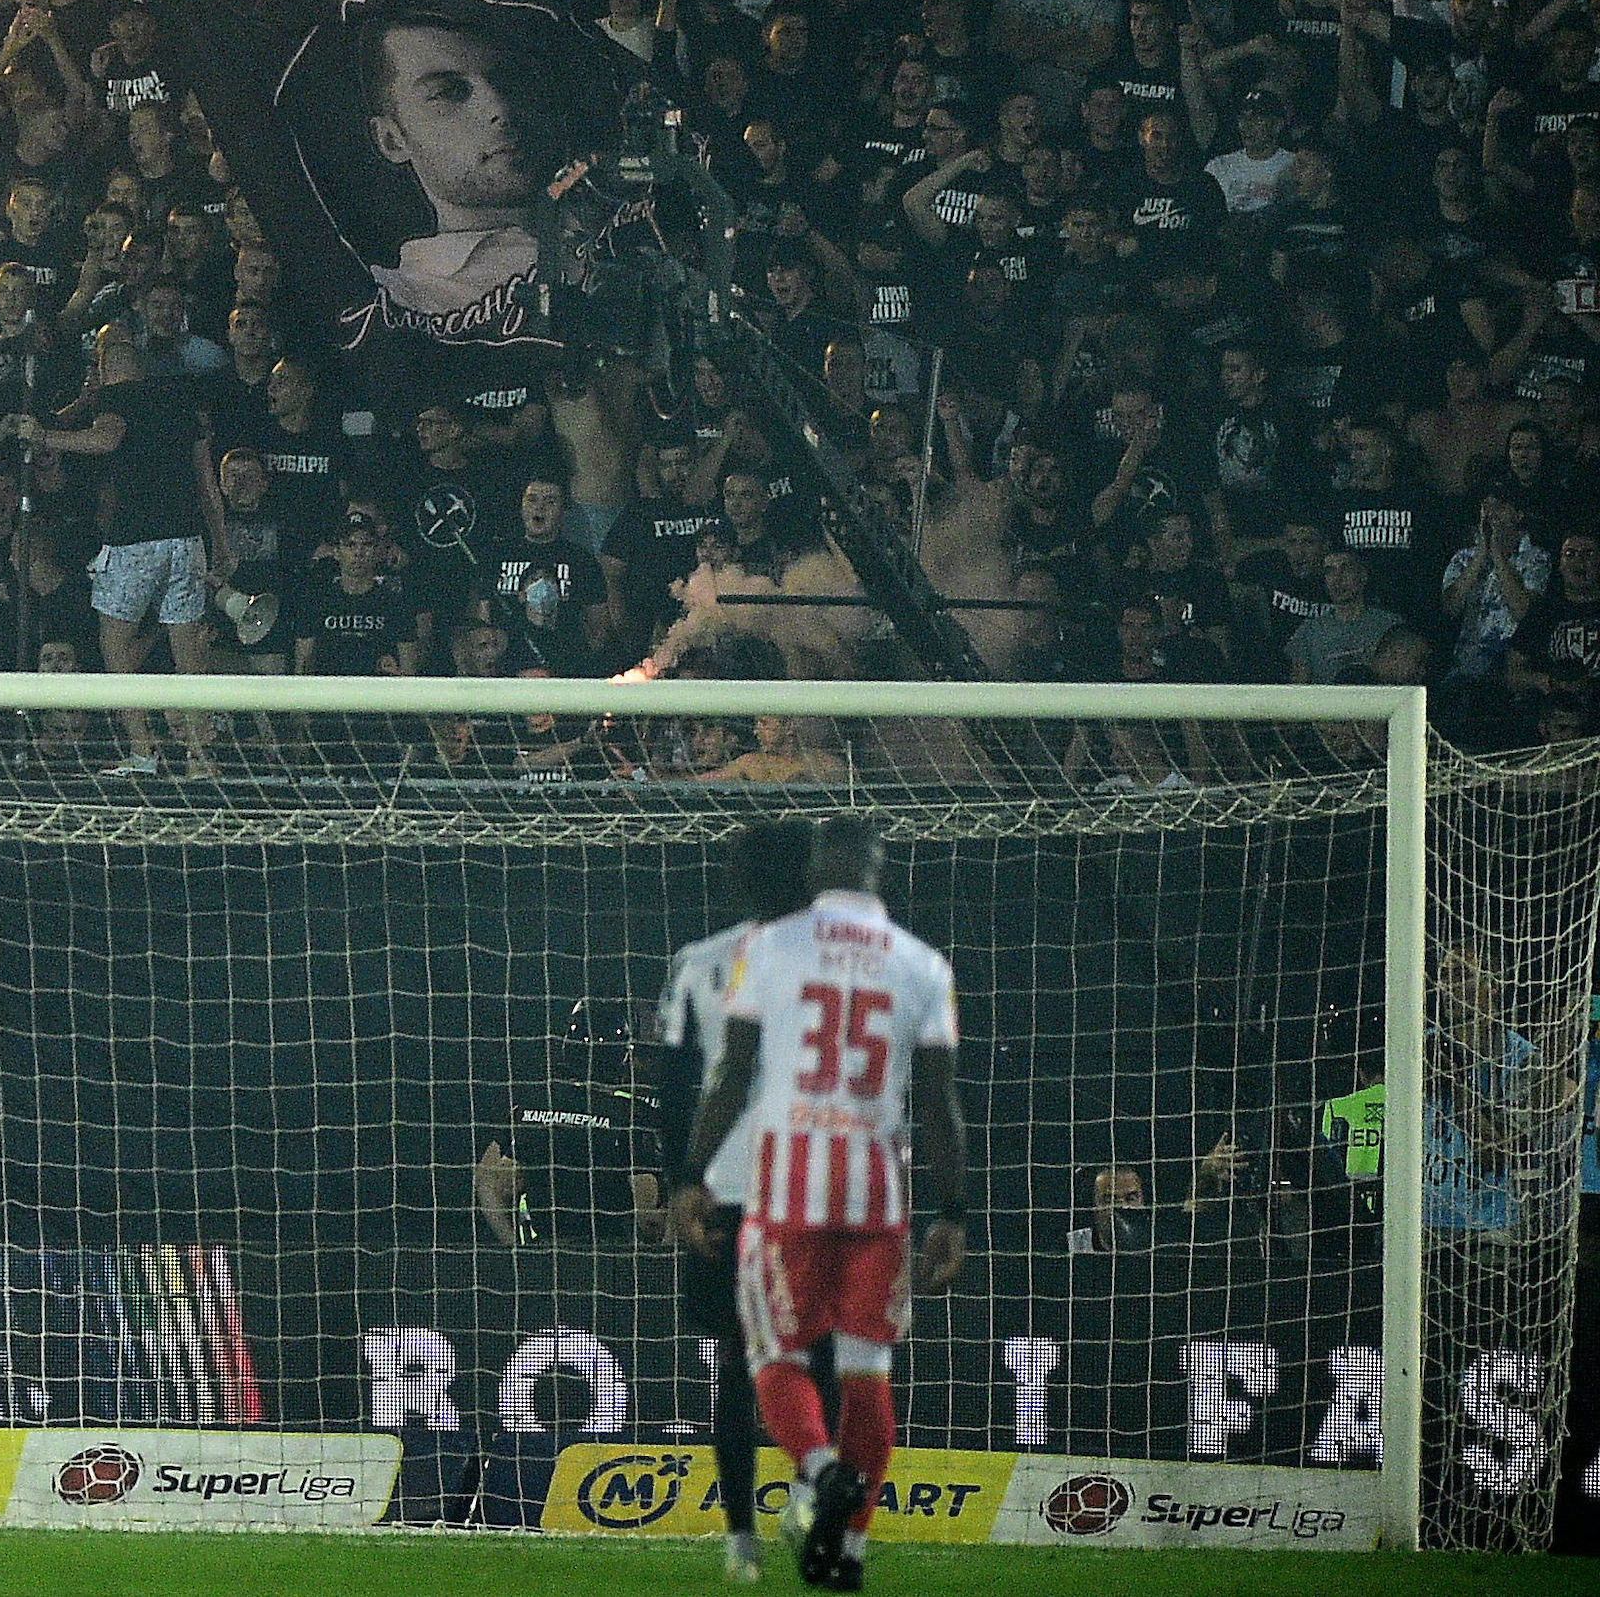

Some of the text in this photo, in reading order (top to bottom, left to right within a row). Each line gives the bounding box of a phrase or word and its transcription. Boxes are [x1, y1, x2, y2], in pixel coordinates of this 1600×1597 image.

[1141, 198, 1174, 213] JUST
[267, 454, 330, 474] РОБАРИ
[323, 614, 386, 630] GUESS
[800, 983, 895, 1100] 35
[153, 1462, 356, 1502] SuperLiga
[1140, 1492, 1347, 1537] SuperLiga
